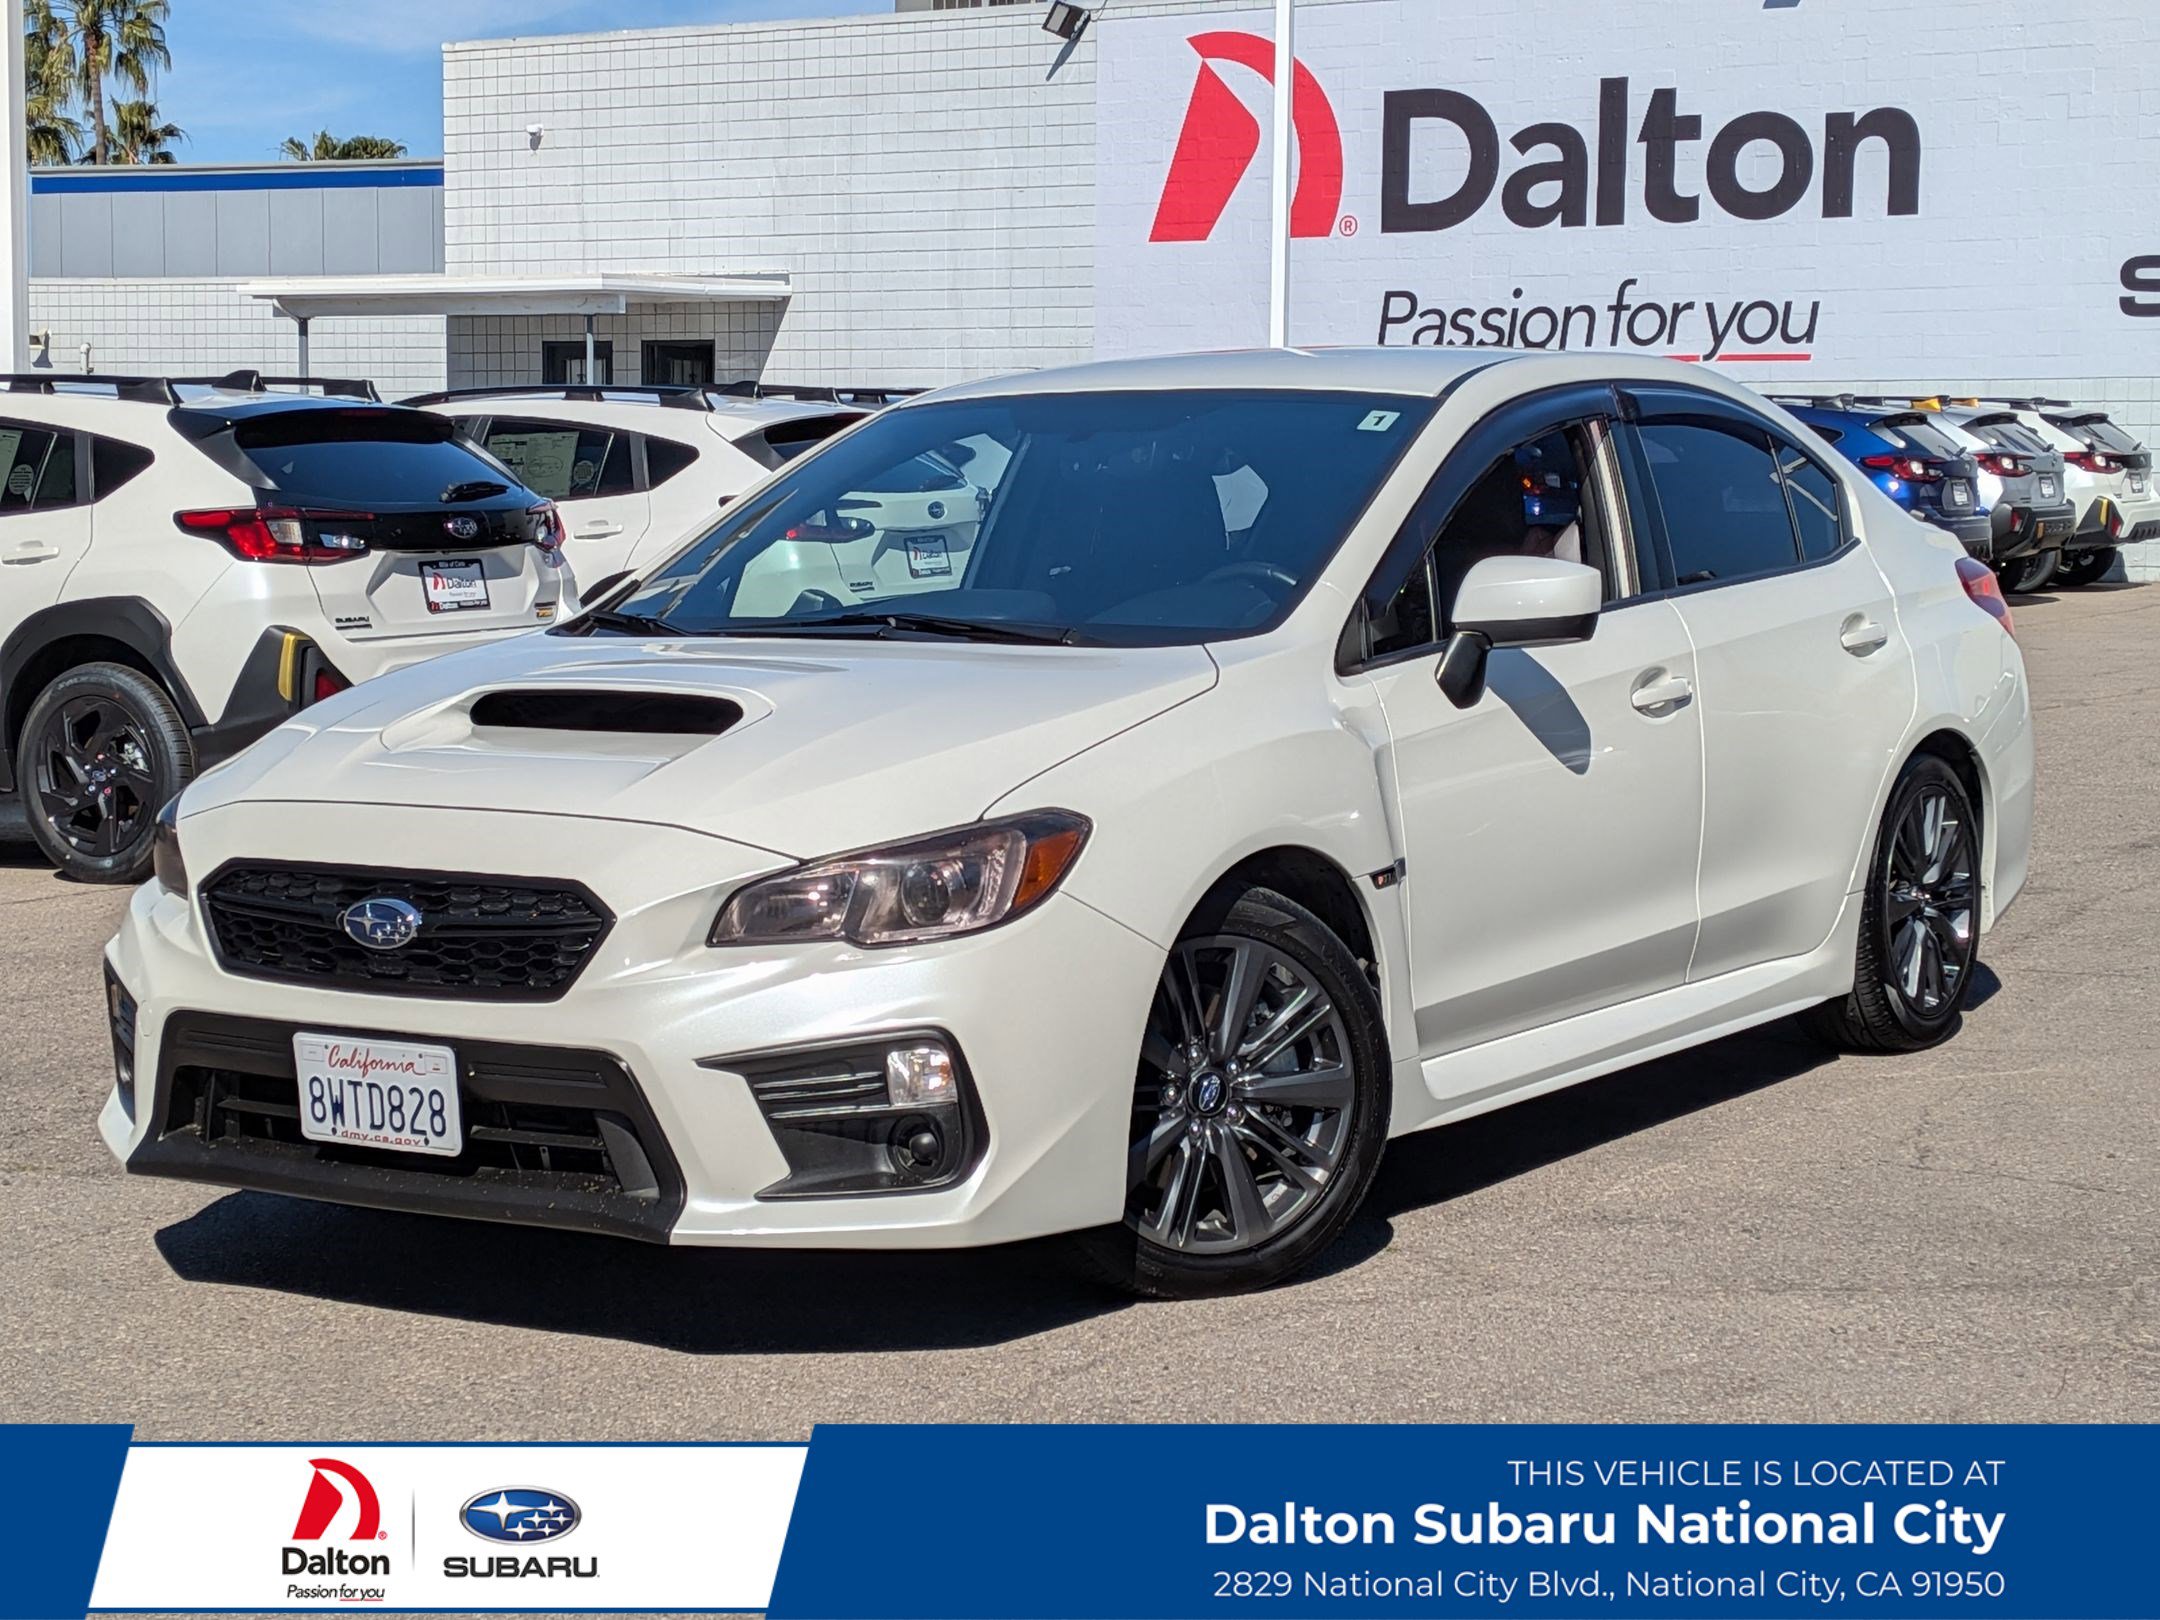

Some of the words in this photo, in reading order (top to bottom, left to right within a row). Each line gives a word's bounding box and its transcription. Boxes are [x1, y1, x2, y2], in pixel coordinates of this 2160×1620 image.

[1381, 76, 1921, 234] Dalton
[1377, 287, 1596, 351] Passion
[1607, 278, 1695, 347] for
[1703, 300, 1820, 361] you
[328, 1044, 427, 1078] California
[308, 1075, 448, 1137] 8WTD828
[340, 1129, 422, 1146] dmv.ca.gov
